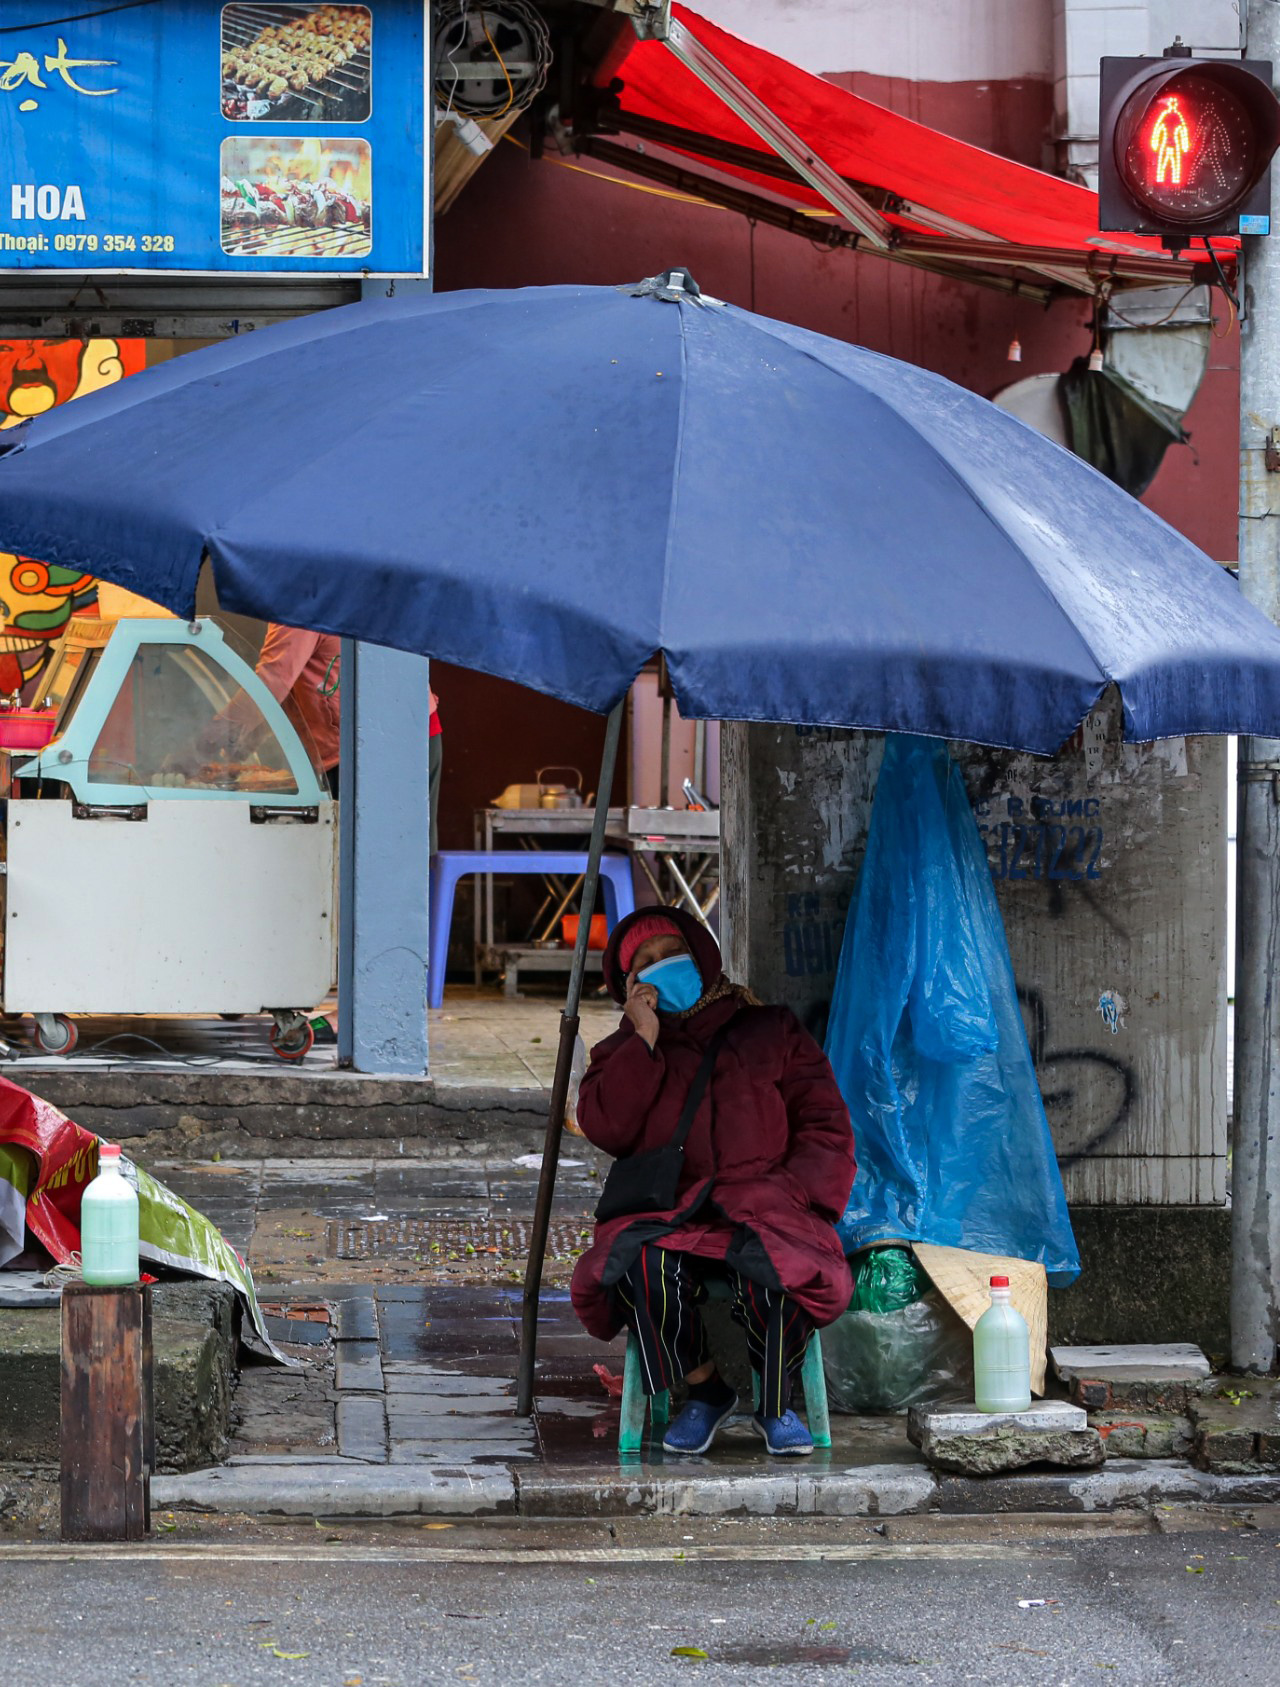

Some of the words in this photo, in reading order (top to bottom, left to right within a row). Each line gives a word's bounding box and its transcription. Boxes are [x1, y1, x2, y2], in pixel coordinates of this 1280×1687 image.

[11, 184, 87, 221] HOA
[54, 234, 99, 251] 0979
[103, 235, 136, 252] 354
[141, 235, 174, 252] 328
